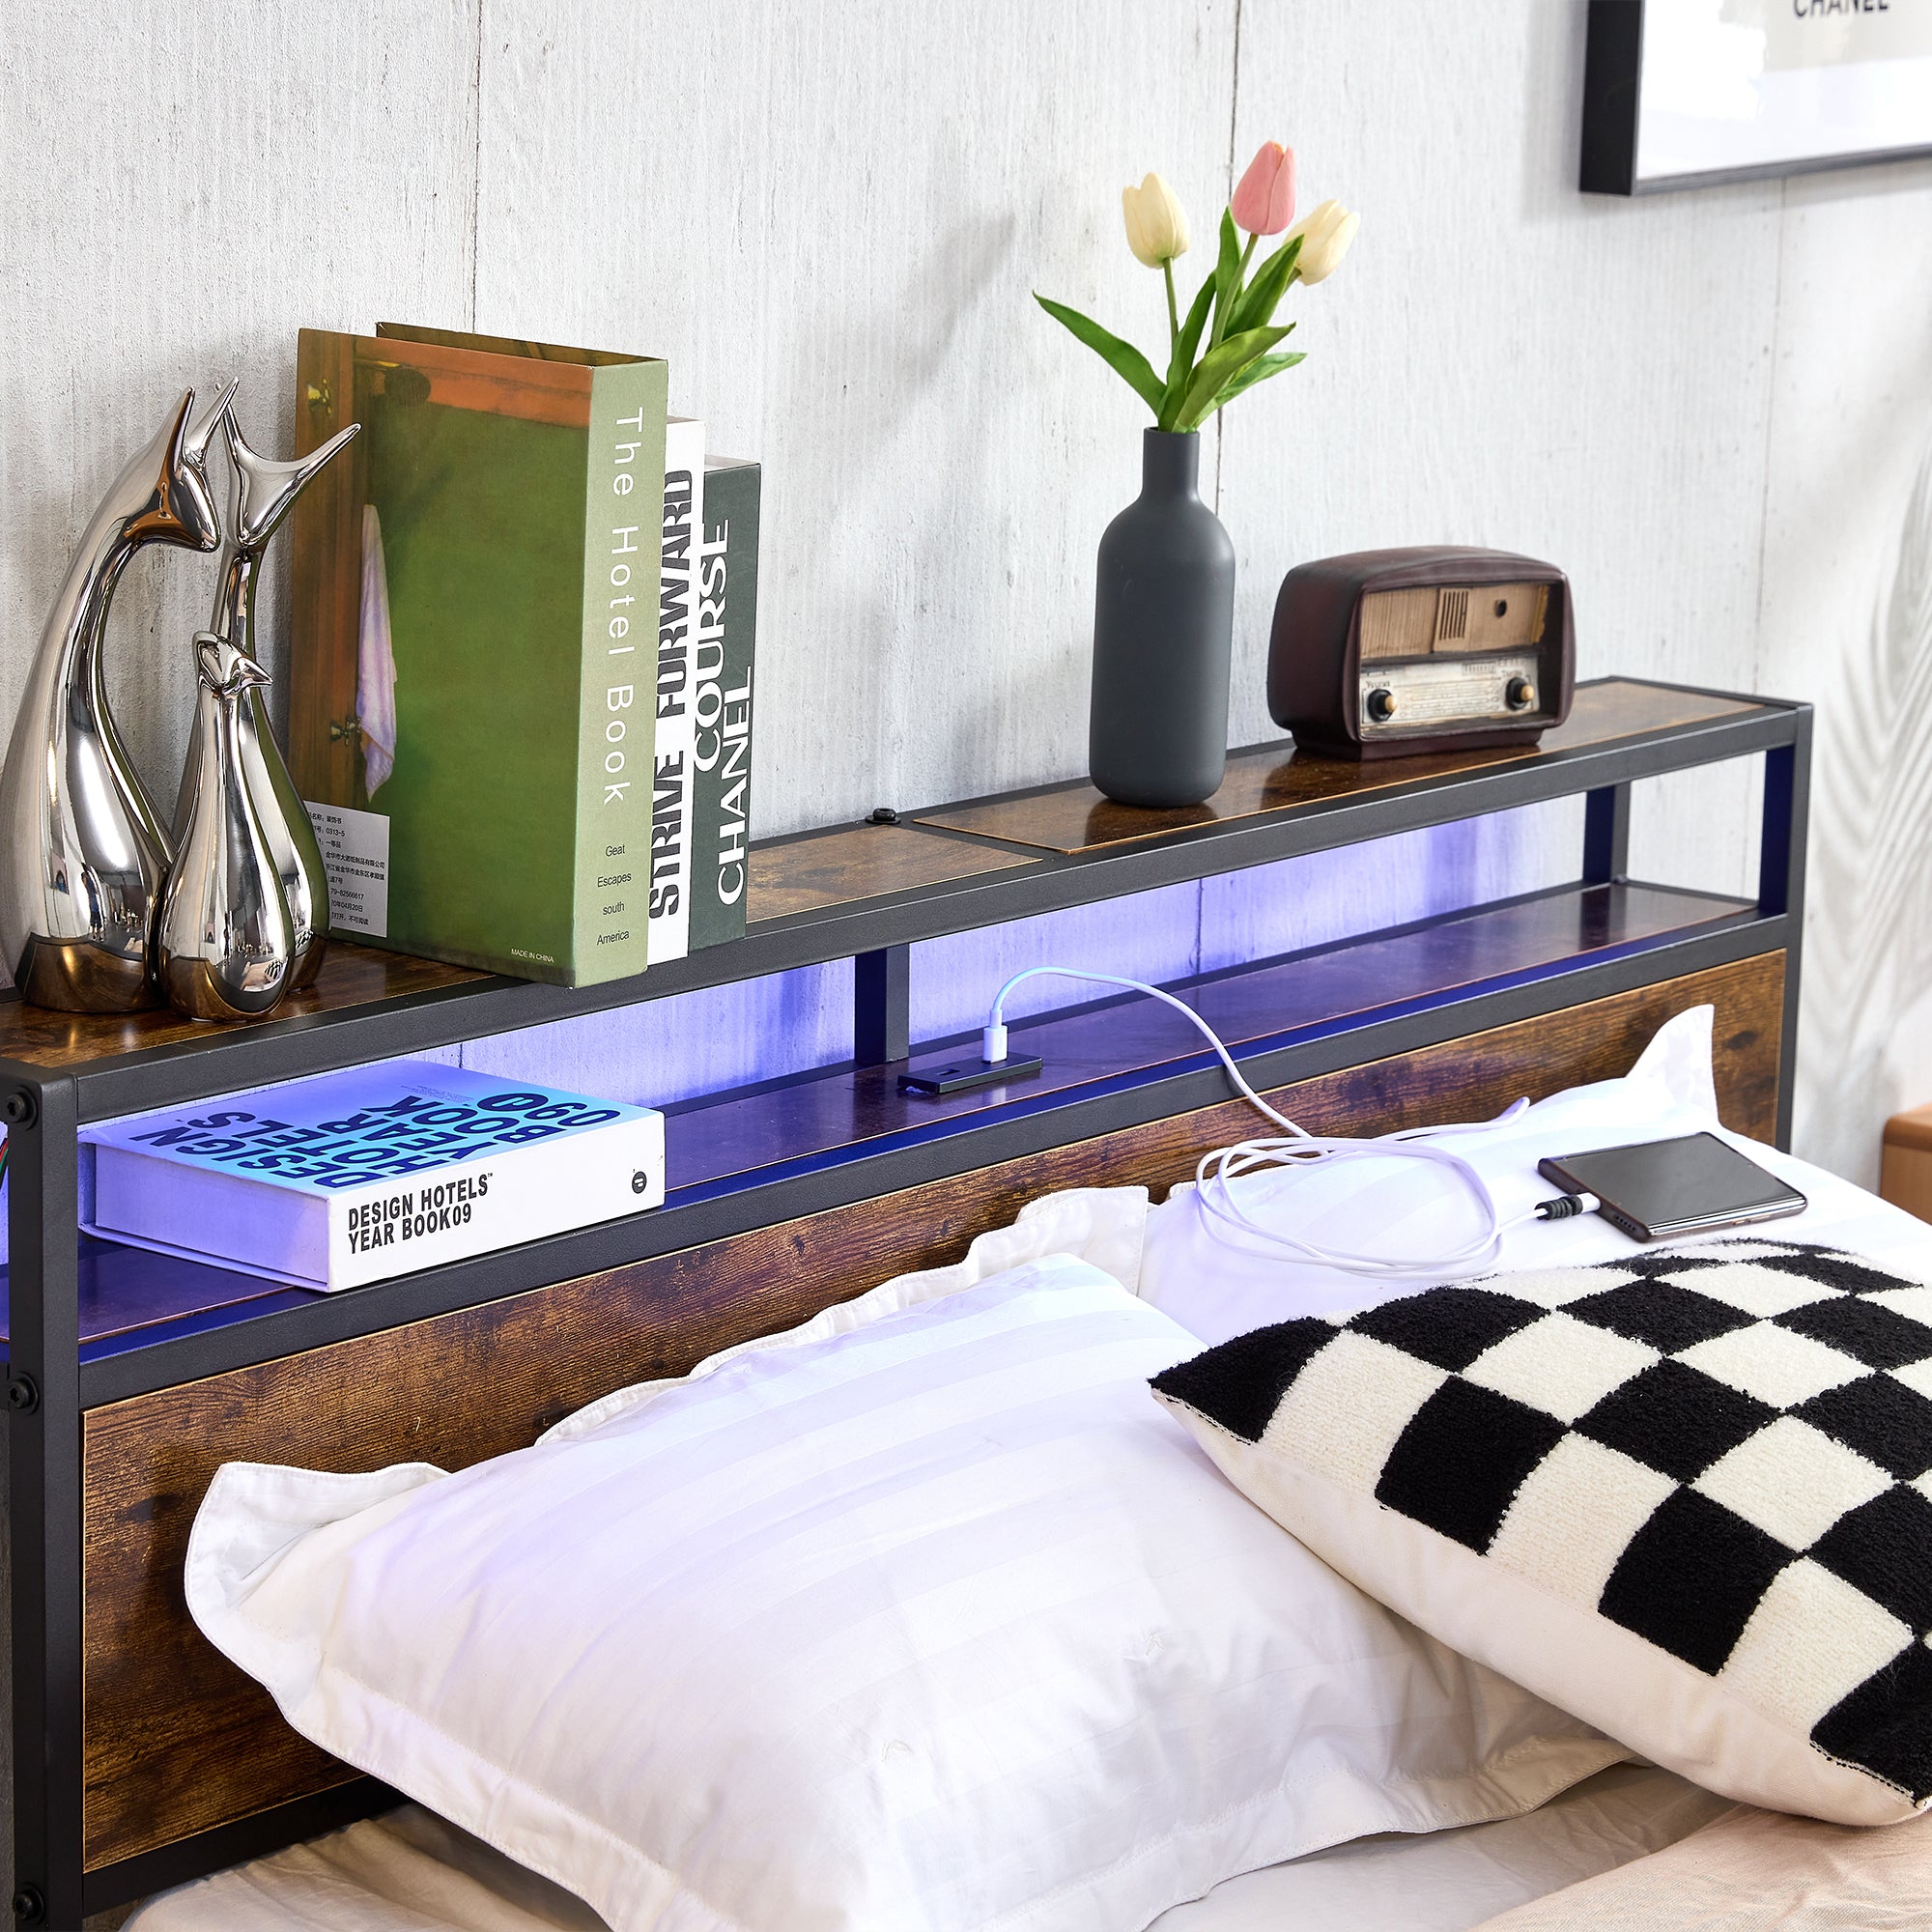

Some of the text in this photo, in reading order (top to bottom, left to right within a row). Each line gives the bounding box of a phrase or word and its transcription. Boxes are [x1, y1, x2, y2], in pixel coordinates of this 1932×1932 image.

[603, 406, 643, 806] The Hotel Book
[693, 519, 730, 773] COURSE
[648, 469, 693, 920] STRIVE FORWARD
[716, 665, 752, 906] CHANEL
[605, 844, 626, 858] Geat
[597, 871, 632, 888] Escapes
[603, 900, 625, 916] south
[511, 948, 528, 958] MADE
[535, 952, 554, 963] CHINA
[596, 928, 630, 946] America
[316, 1112, 498, 1160] YEAR
[360, 1094, 567, 1144] BOOK
[128, 1125, 389, 1189] DESIGN
[349, 1193, 413, 1231] DESIGN
[348, 1222, 395, 1255] YEAR
